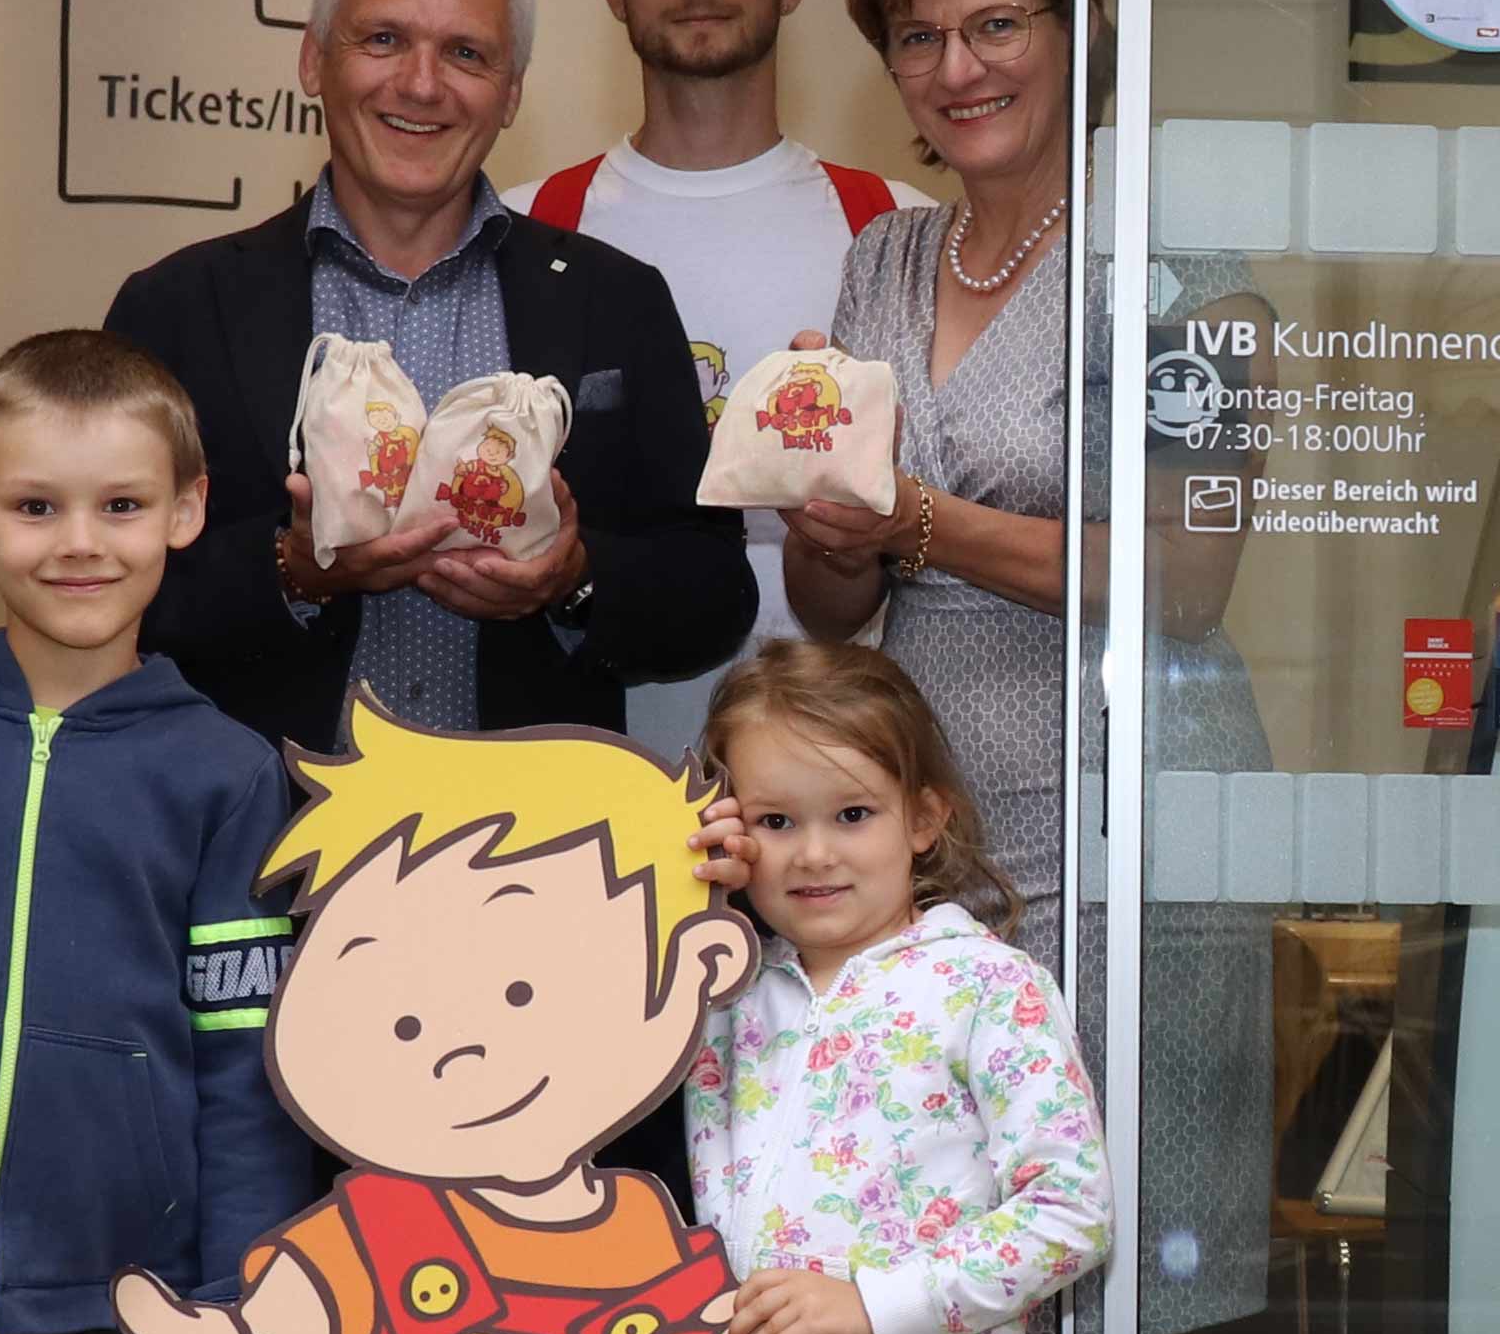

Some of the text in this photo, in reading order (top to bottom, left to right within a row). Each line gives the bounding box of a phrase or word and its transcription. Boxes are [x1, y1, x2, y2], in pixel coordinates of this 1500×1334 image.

[1186, 320, 1257, 357] IVB
[1185, 383, 1415, 418] Montag-Freitag
[755, 404, 853, 432] Peterle
[781, 429, 833, 453] hilft
[1252, 478, 1478, 504] Dieser Bereich wird
[1251, 510, 1440, 535] videoüberwacht
